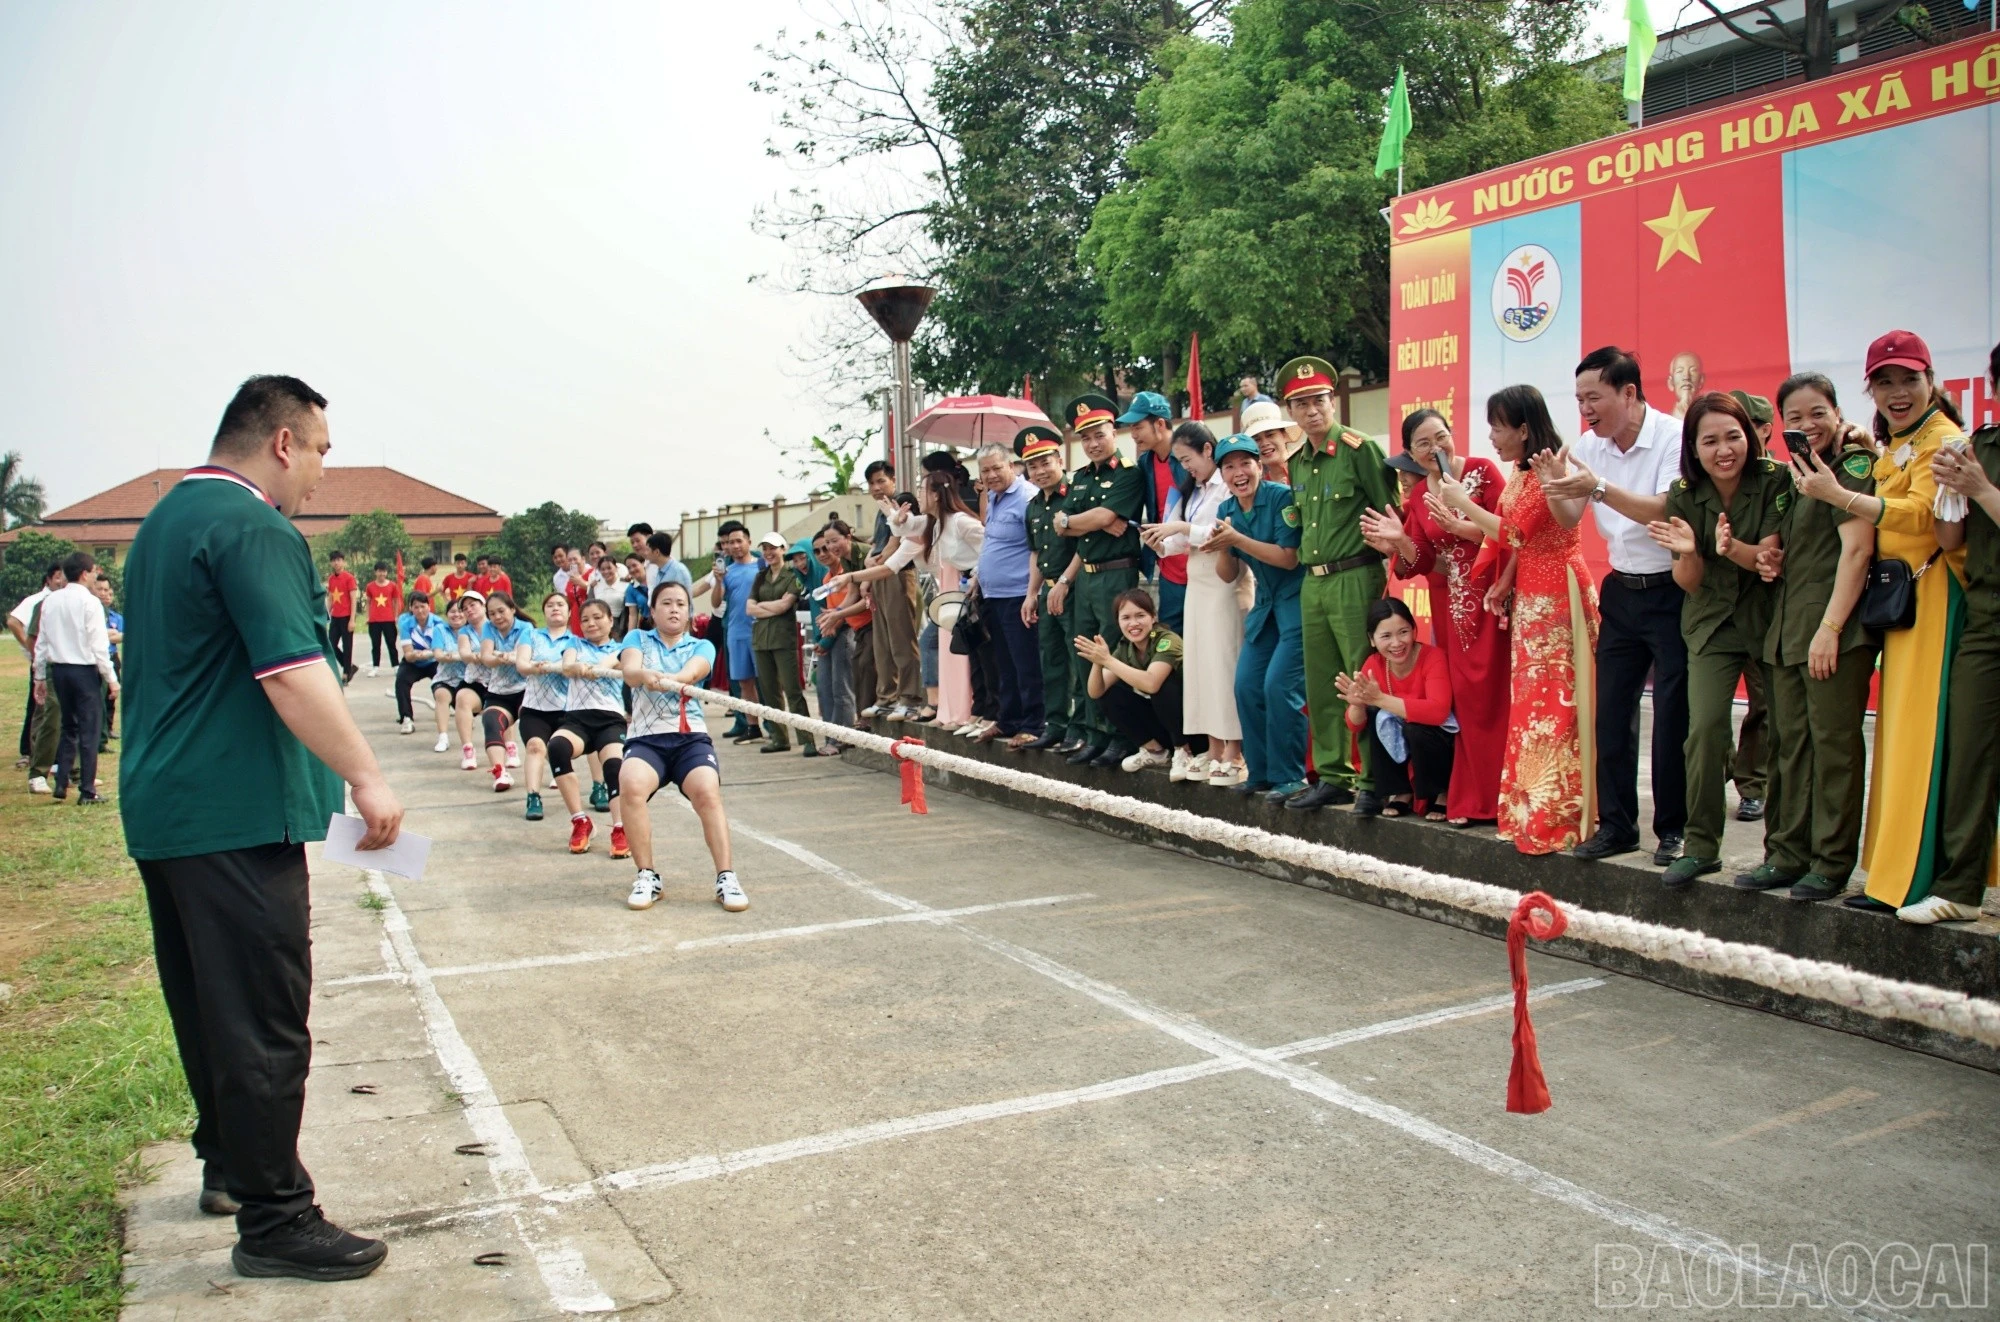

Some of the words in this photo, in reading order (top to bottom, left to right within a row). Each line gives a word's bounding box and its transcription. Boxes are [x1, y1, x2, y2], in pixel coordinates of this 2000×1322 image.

[1474, 163, 1574, 216] NƯỚC
[1588, 131, 1705, 185] CỘNG
[1721, 103, 1822, 152] HÒA
[1837, 71, 1913, 126] XÃ
[1400, 275, 1430, 311] TOÀN
[1431, 269, 1456, 305] DÂN
[1397, 336, 1421, 372] RÈN
[1422, 330, 1458, 372] LUYỆN
